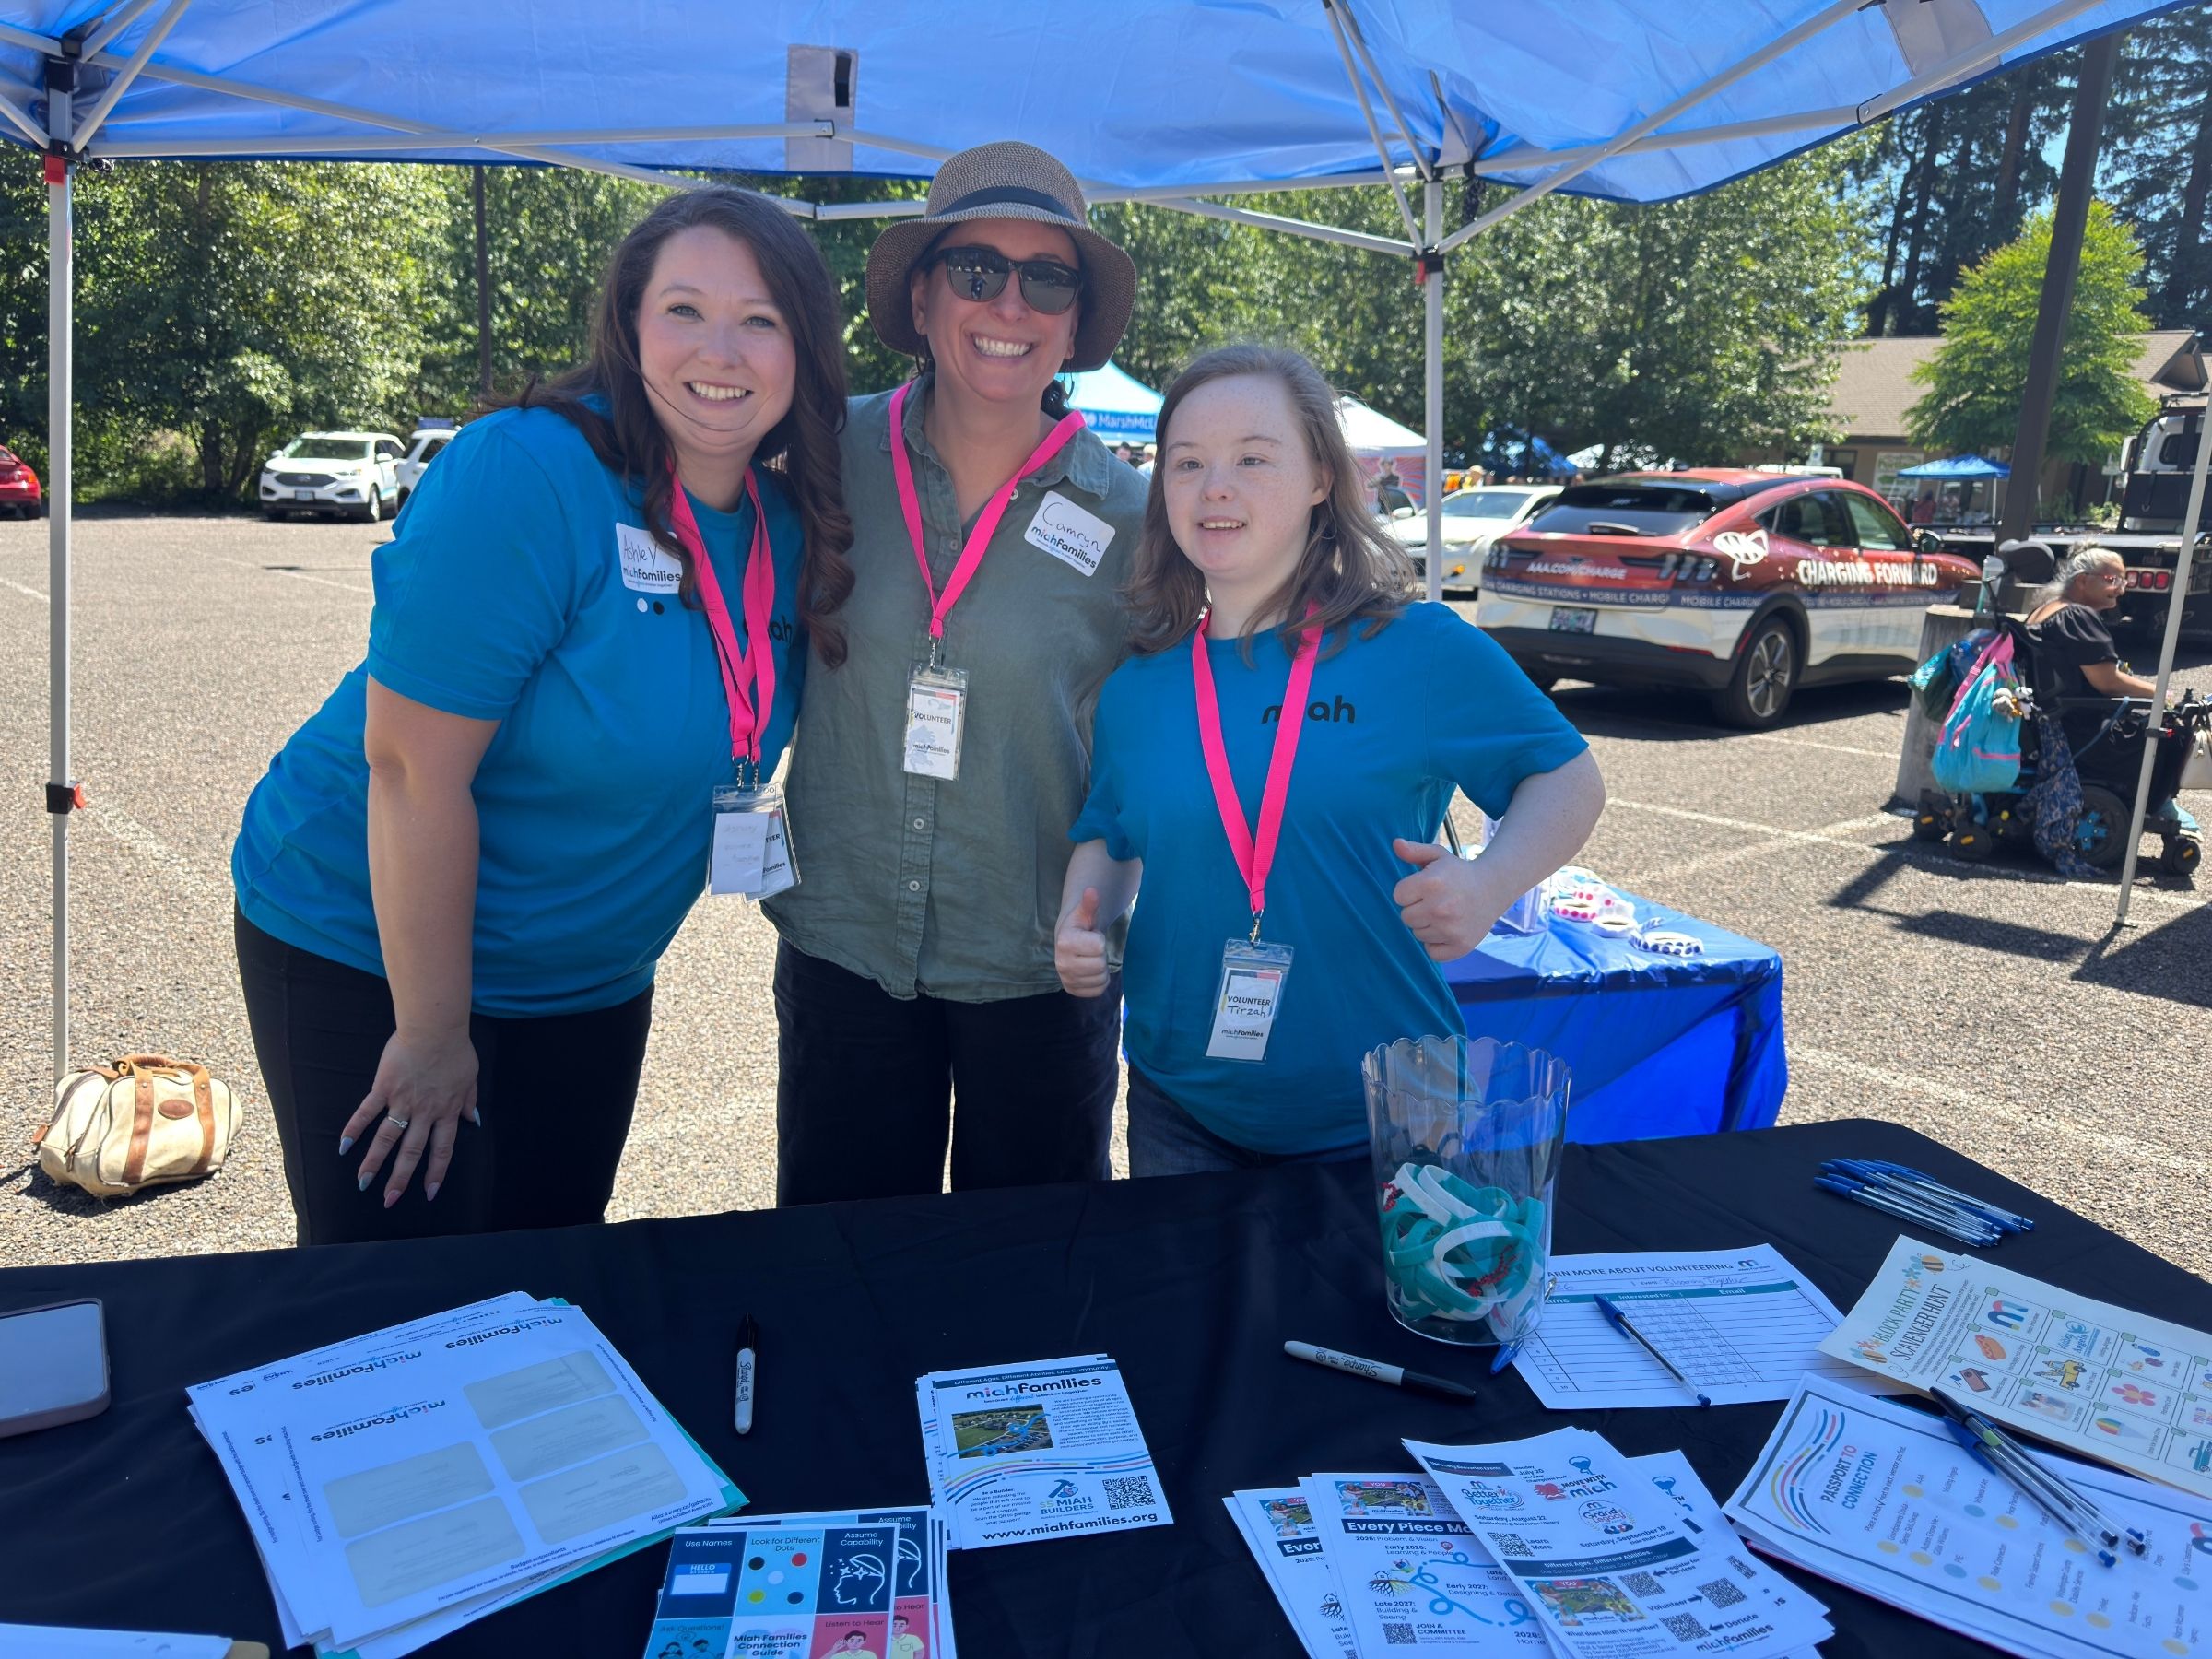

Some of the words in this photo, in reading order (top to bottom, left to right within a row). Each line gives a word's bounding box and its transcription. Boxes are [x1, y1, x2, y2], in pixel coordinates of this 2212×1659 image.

[1042, 501, 1101, 553] Camryn
[623, 534, 657, 571] Ashley
[1798, 559, 1874, 585] CHARGING
[1876, 561, 1937, 586] FORWARD
[1538, 586, 1581, 600] STATIONS
[1589, 591, 1626, 603] MOBILE
[1681, 595, 1722, 606] MOBILE
[1261, 694, 1355, 724] mah
[914, 712, 952, 724] VOLUNTEER
[763, 862, 786, 874] families
[1228, 996, 1271, 1006] VOLUNTEER
[1228, 1006, 1266, 1018] Tirzah
[1572, 1268, 1606, 1277] MORE
[1608, 1266, 1646, 1275] ABOUT
[1648, 1264, 1734, 1274] VOLUNTEERING
[1618, 1292, 1659, 1300] Interested
[1873, 1315, 1904, 1343] BLOCK
[1889, 1286, 1921, 1318] PARTY
[1890, 1312, 1938, 1361] SCAVENGER
[1922, 1283, 1952, 1316] HUNT
[1343, 1357, 1382, 1377] Sharpie
[966, 1377, 1102, 1400] miahfamilies
[1820, 1457, 1852, 1503] PASSPORT
[1841, 1444, 1858, 1459] TO
[1561, 1478, 1585, 1488] MOVE
[1587, 1475, 1606, 1483] WITH
[1841, 1451, 1877, 1510] CONNECTION
[1461, 1488, 1499, 1498] Better
[1056, 1496, 1093, 1507] MIAH
[1465, 1494, 1516, 1506] Together
[1041, 1503, 1095, 1515] BUILDERS
[1583, 1508, 1618, 1520] Grand
[1475, 1514, 1509, 1523] Saturday,
[982, 1512, 1159, 1541] www.miahfamilies.org
[1347, 1522, 1394, 1535] Every
[1397, 1522, 1444, 1533] Piece
[685, 1539, 700, 1547] Use
[751, 1537, 770, 1547] Look
[771, 1537, 783, 1546] for
[784, 1535, 820, 1546] Different
[840, 1537, 884, 1547] Capability
[1580, 1539, 1618, 1548] Saturday,
[1618, 1528, 1658, 1543] September
[1284, 1542, 1321, 1554] Ever
[510, 1558, 532, 1570] Badges
[690, 1563, 716, 1571] HELLO
[1593, 1556, 1623, 1566] Different
[1448, 1590, 1488, 1598] Designing
[904, 1603, 925, 1611] Hear
[1647, 1599, 1688, 1612] Volunteer
[825, 1618, 850, 1629] Listen
[864, 1618, 885, 1627] Hear
[1379, 1614, 1408, 1622] Seeing
[1724, 1614, 1759, 1629] Donate
[1331, 1626, 1349, 1634] Late
[734, 1634, 762, 1642] Miah
[763, 1632, 808, 1641] Families
[738, 1641, 801, 1650] Connection
[751, 1649, 784, 1657] Guide
